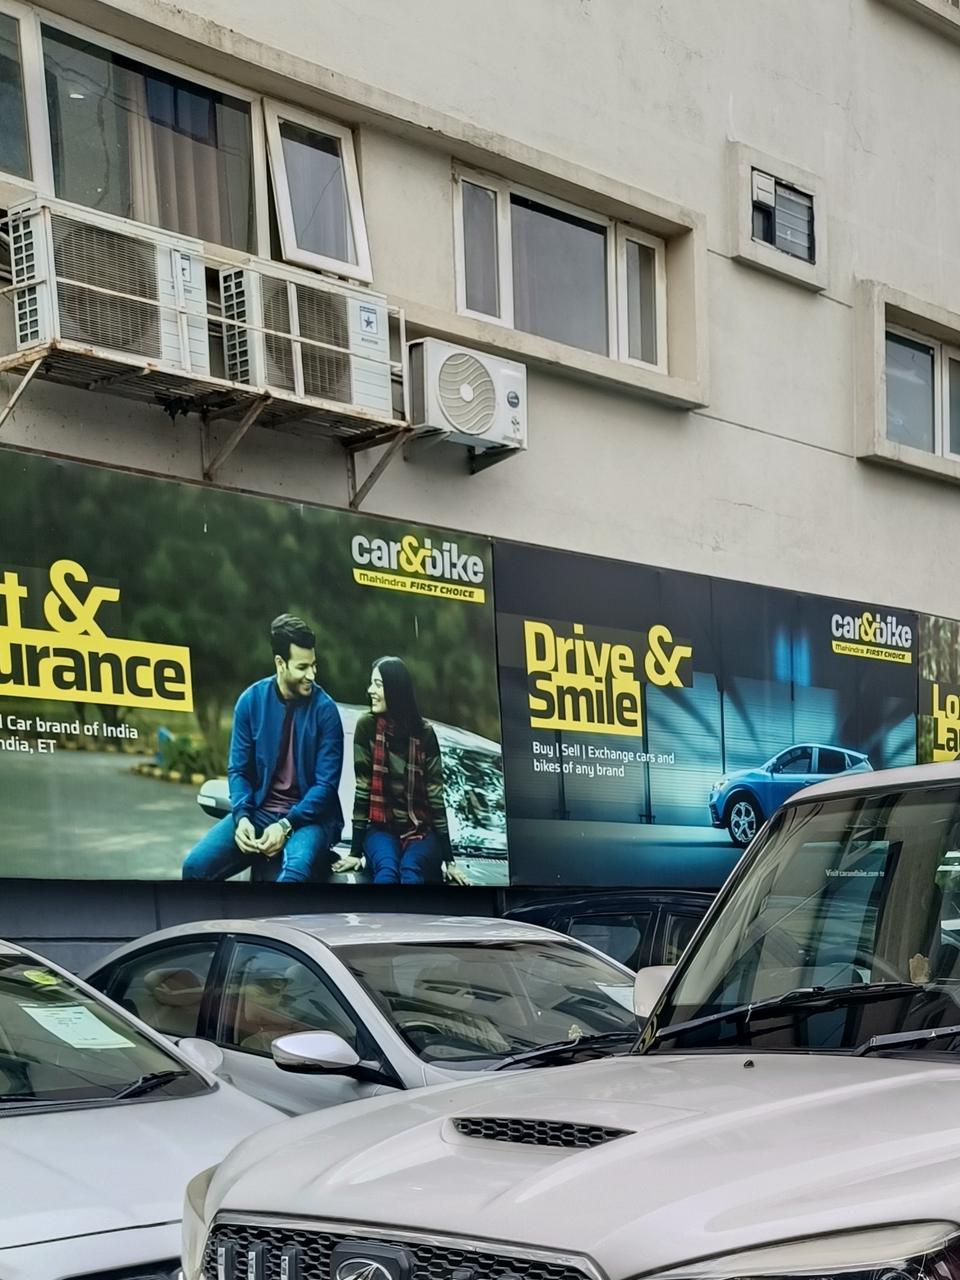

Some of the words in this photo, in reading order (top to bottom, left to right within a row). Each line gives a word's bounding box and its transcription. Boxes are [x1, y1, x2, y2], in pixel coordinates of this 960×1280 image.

[352, 535, 484, 584] car&bike
[44, 559, 120, 639] &
[360, 572, 407, 589] Mahindra
[410, 581, 438, 594] FIRST
[440, 586, 475, 599] CHOICE
[831, 612, 912, 648] car&bike
[524, 620, 635, 682] Drive
[644, 624, 693, 688] &
[866, 647, 884, 657] FIRST
[884, 651, 906, 661] CHOICE
[0, 642, 187, 701] urance
[528, 670, 639, 728] Smile
[7, 715, 33, 731] Car
[36, 716, 80, 736] brand
[84, 721, 100, 737] of
[103, 722, 138, 740] India
[38, 739, 56, 753] ET
[532, 741, 553, 758] Buy
[561, 744, 580, 757] Sell
[588, 746, 634, 763] Exchange
[636, 752, 656, 763] cars
[657, 752, 675, 764] and
[533, 759, 561, 773] bikes
[562, 762, 575, 774] of
[575, 765, 595, 777] any
[596, 764, 625, 777] brand
